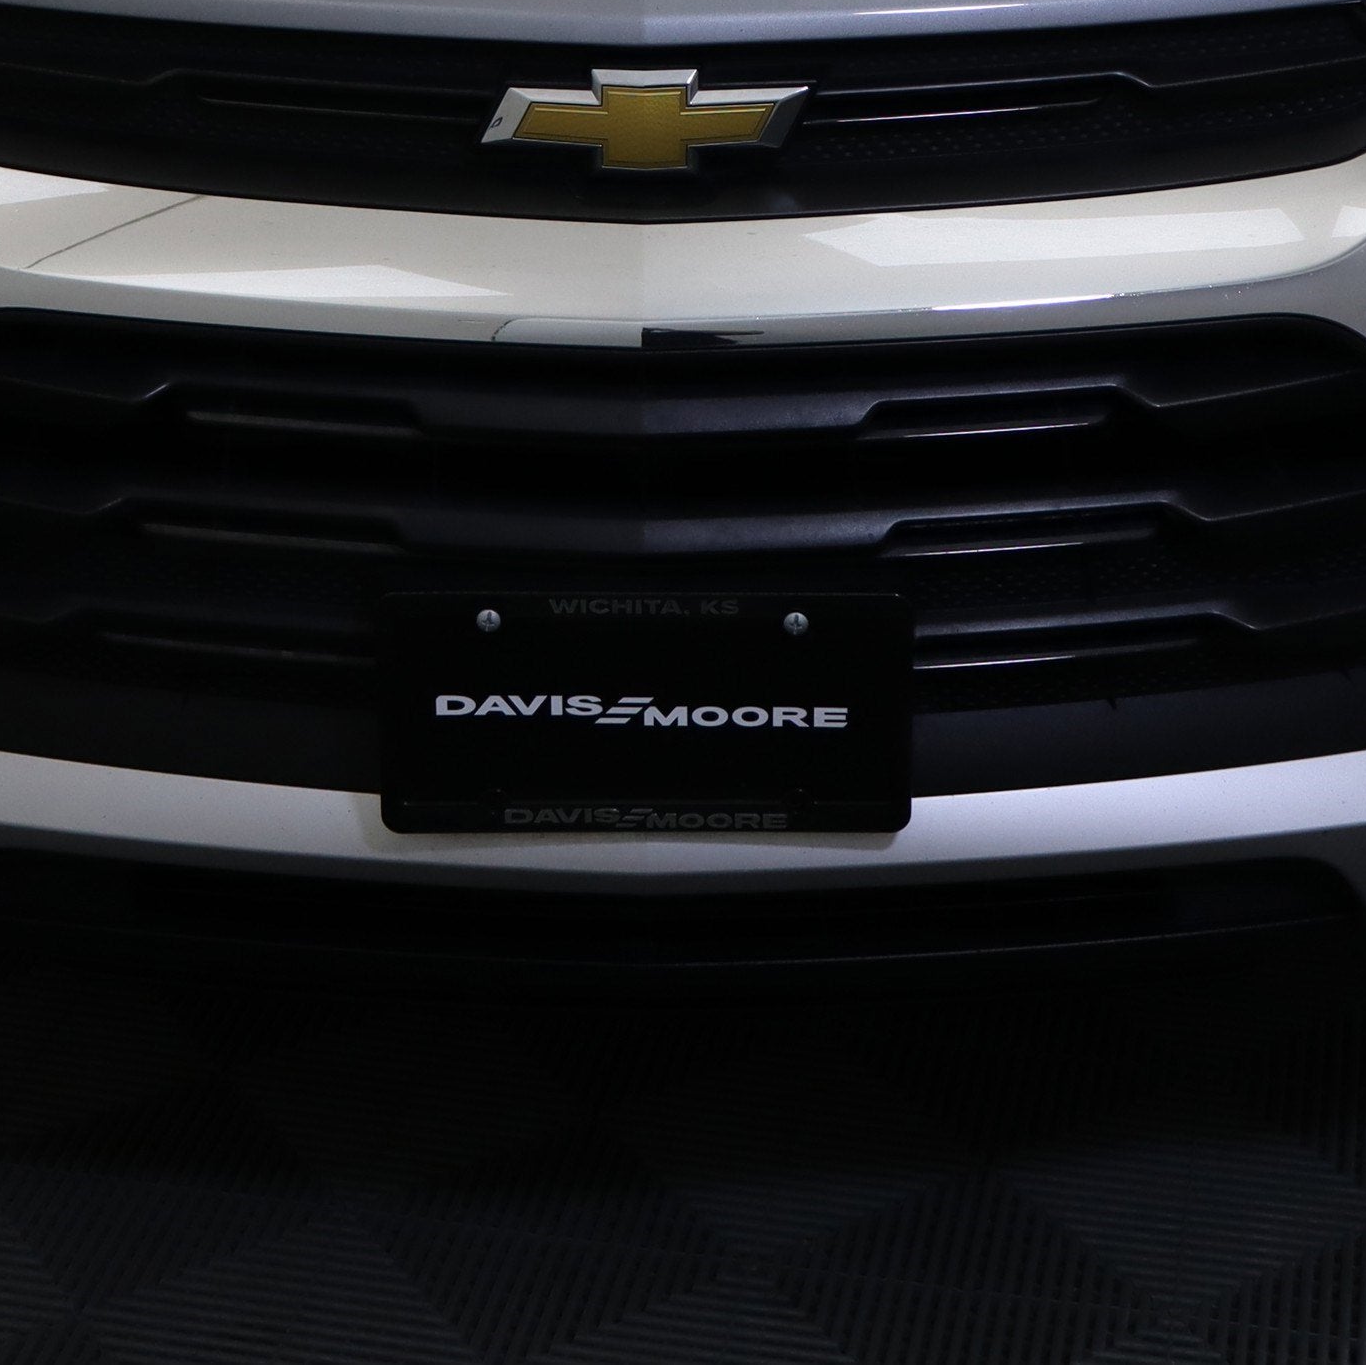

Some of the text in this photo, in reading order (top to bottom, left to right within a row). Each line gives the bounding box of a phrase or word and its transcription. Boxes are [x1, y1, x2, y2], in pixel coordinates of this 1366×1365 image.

[700, 598, 740, 615] KS
[435, 694, 849, 729] DAVIS MOORE
[503, 807, 788, 829] DAVIS MOORE
